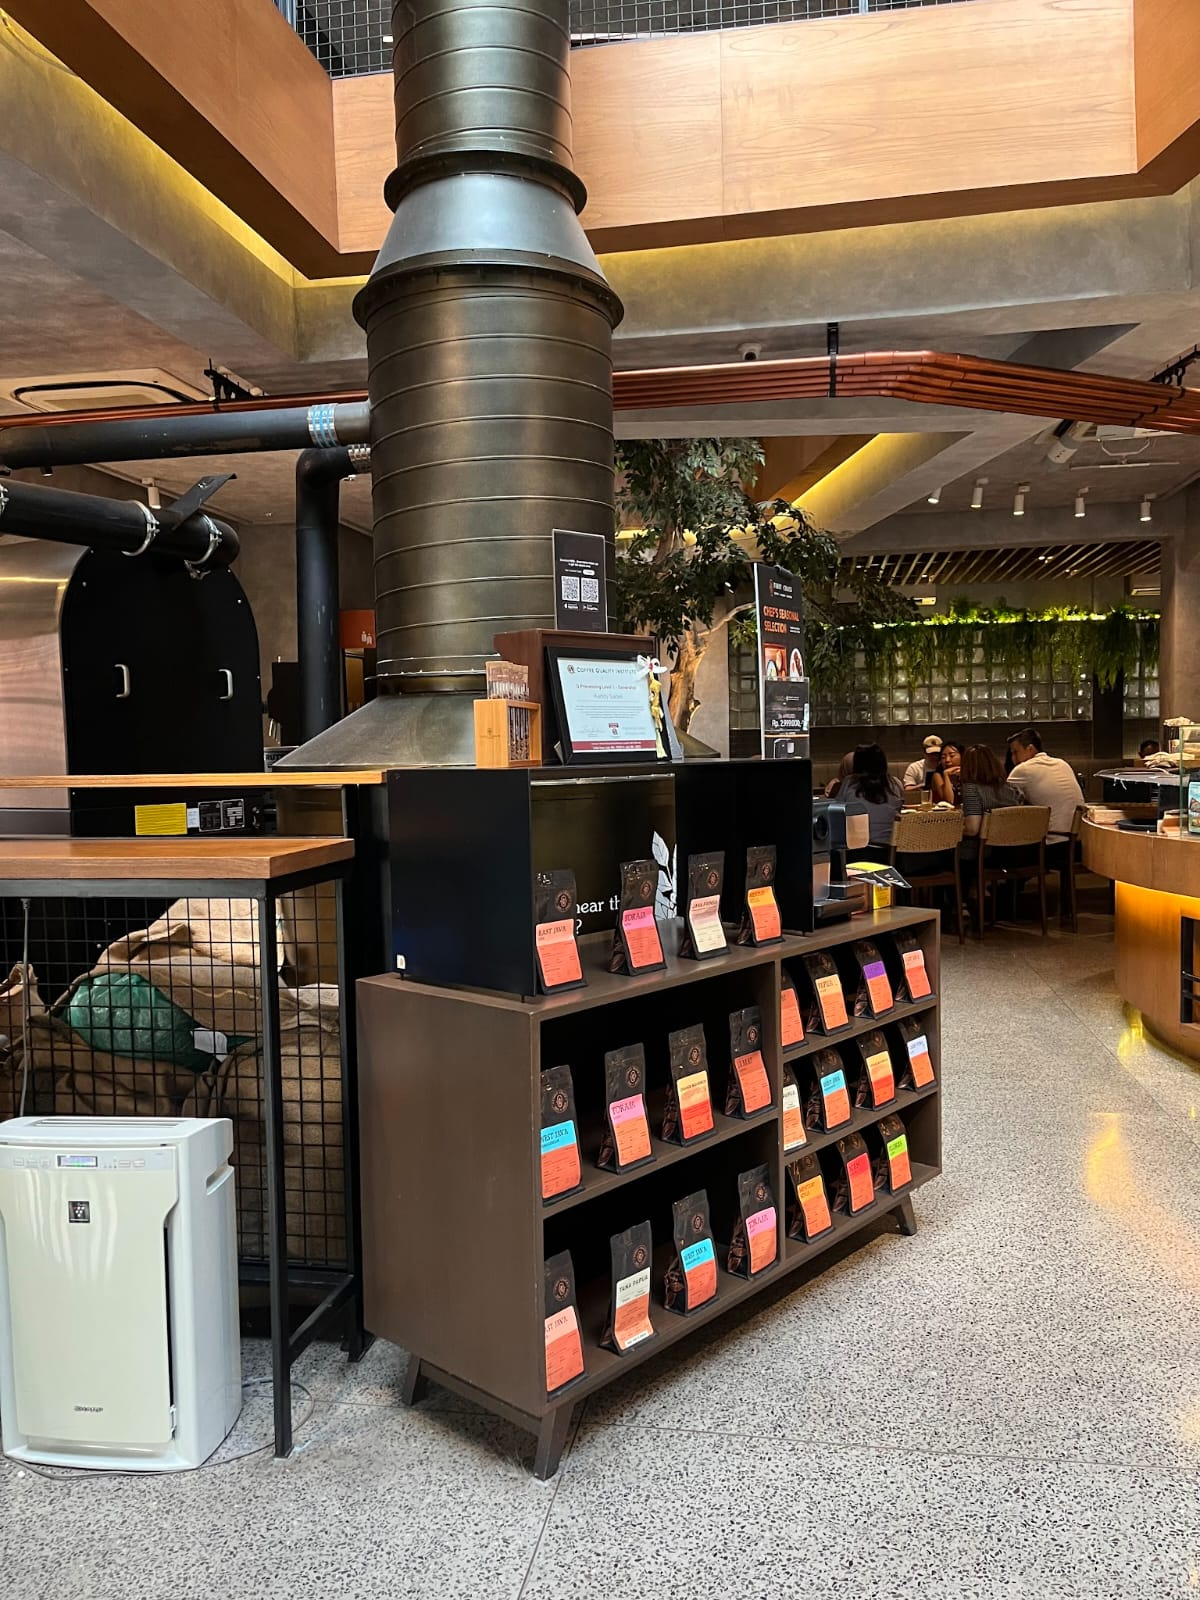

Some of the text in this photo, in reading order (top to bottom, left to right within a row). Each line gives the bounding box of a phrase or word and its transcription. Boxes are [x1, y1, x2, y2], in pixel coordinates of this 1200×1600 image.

[763, 605, 800, 622] CHEF'S SEASONAL
[764, 620, 788, 634] SELECTION
[553, 925, 567, 934] JAVA
[555, 1128, 569, 1139] JAVA
